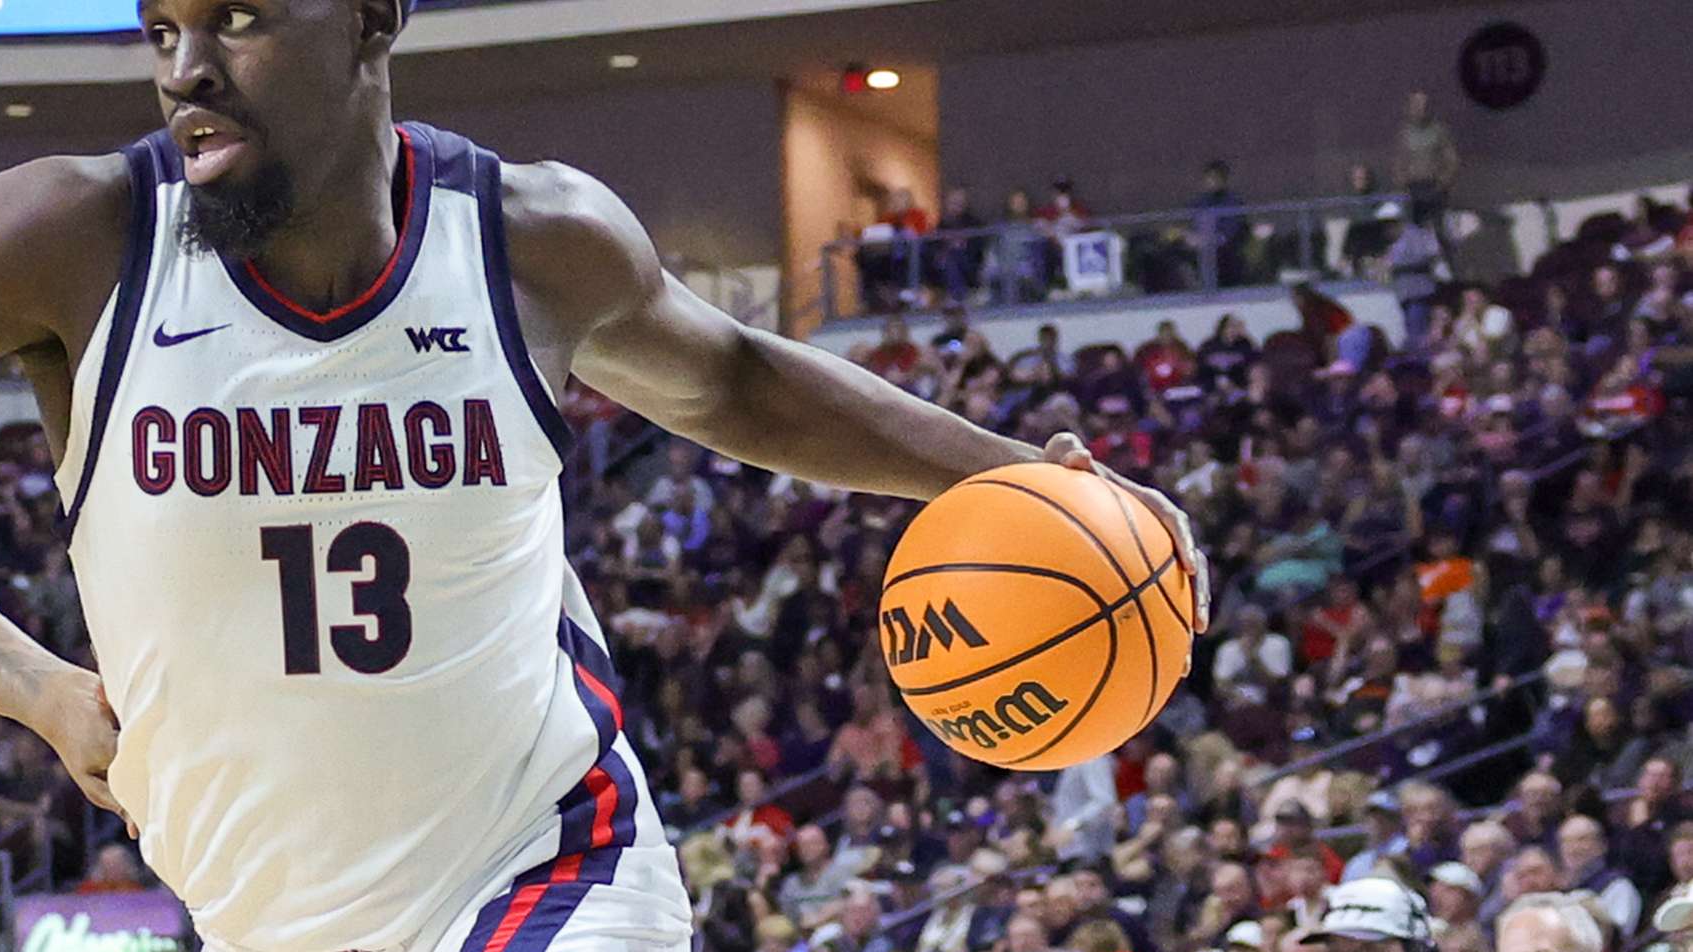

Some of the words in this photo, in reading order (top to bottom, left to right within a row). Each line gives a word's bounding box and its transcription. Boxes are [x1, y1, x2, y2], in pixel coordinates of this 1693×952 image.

[405, 326, 471, 354] WCC
[131, 398, 508, 498] GONZAGA
[259, 520, 413, 676] 13
